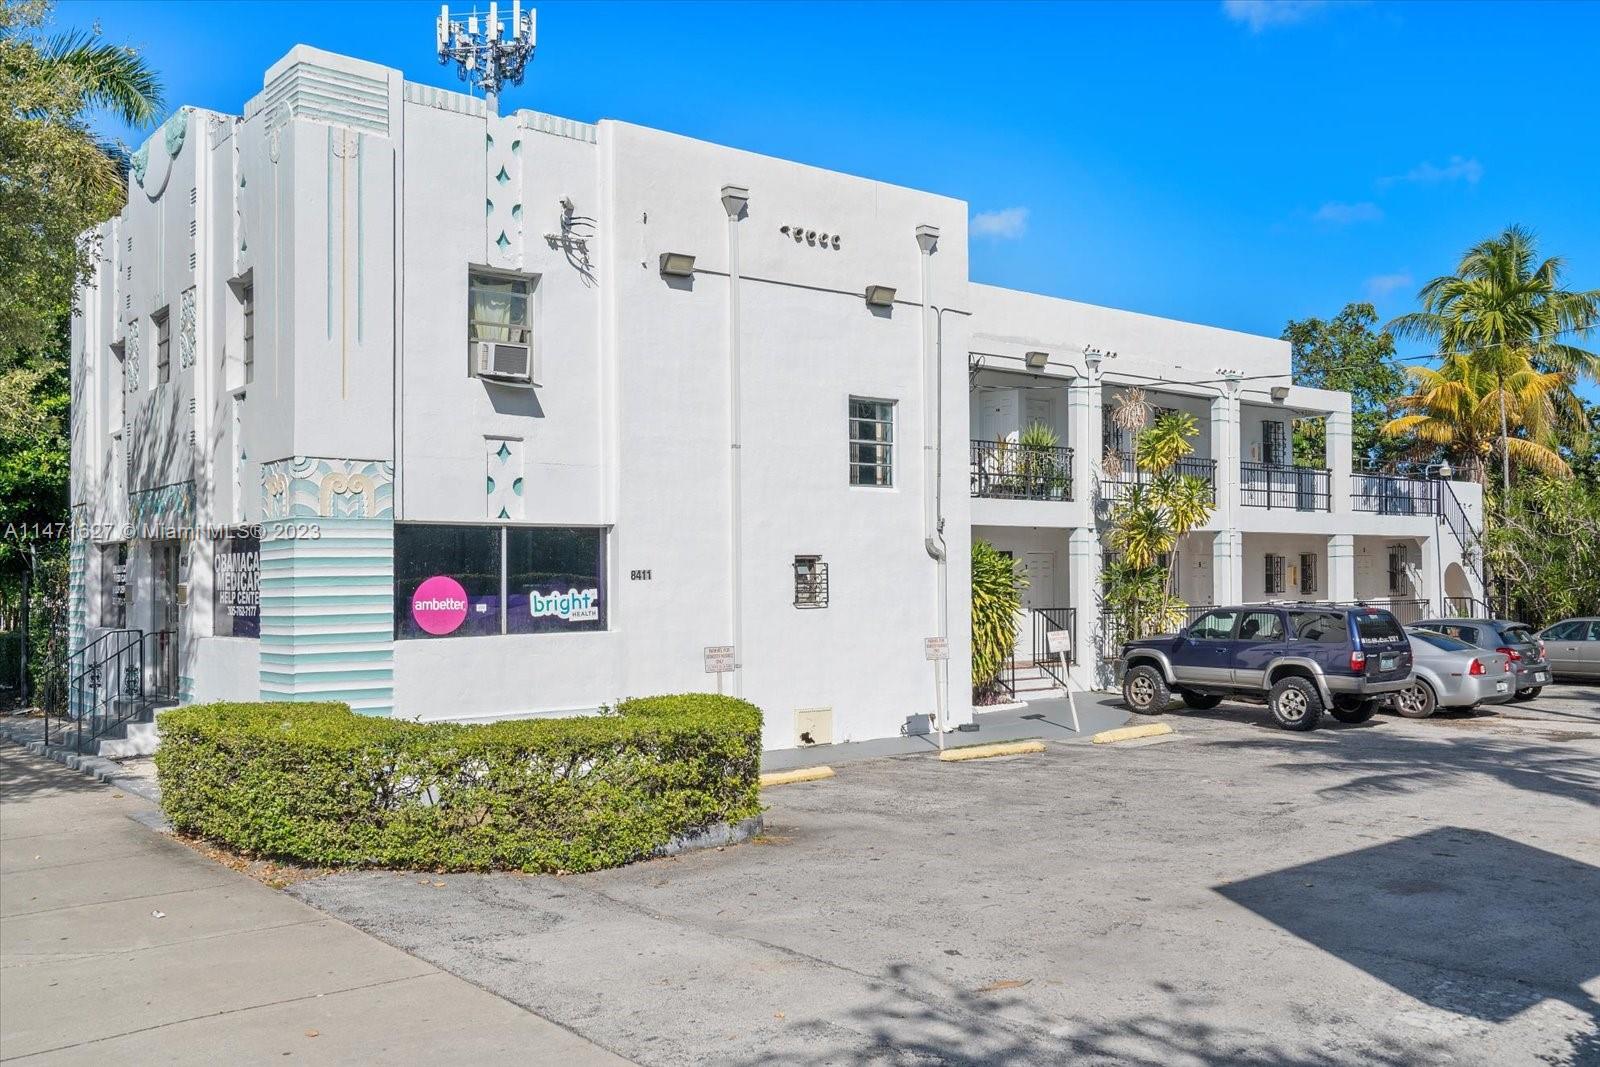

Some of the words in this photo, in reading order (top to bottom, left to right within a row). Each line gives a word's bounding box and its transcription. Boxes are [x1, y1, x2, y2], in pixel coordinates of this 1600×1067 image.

[214, 551, 260, 573] OBAMACA
[217, 571, 261, 591] MEDICAR
[630, 569, 651, 581] 8411
[219, 591, 236, 604] HELP
[237, 591, 260, 604] CENTE
[533, 592, 591, 615] bright
